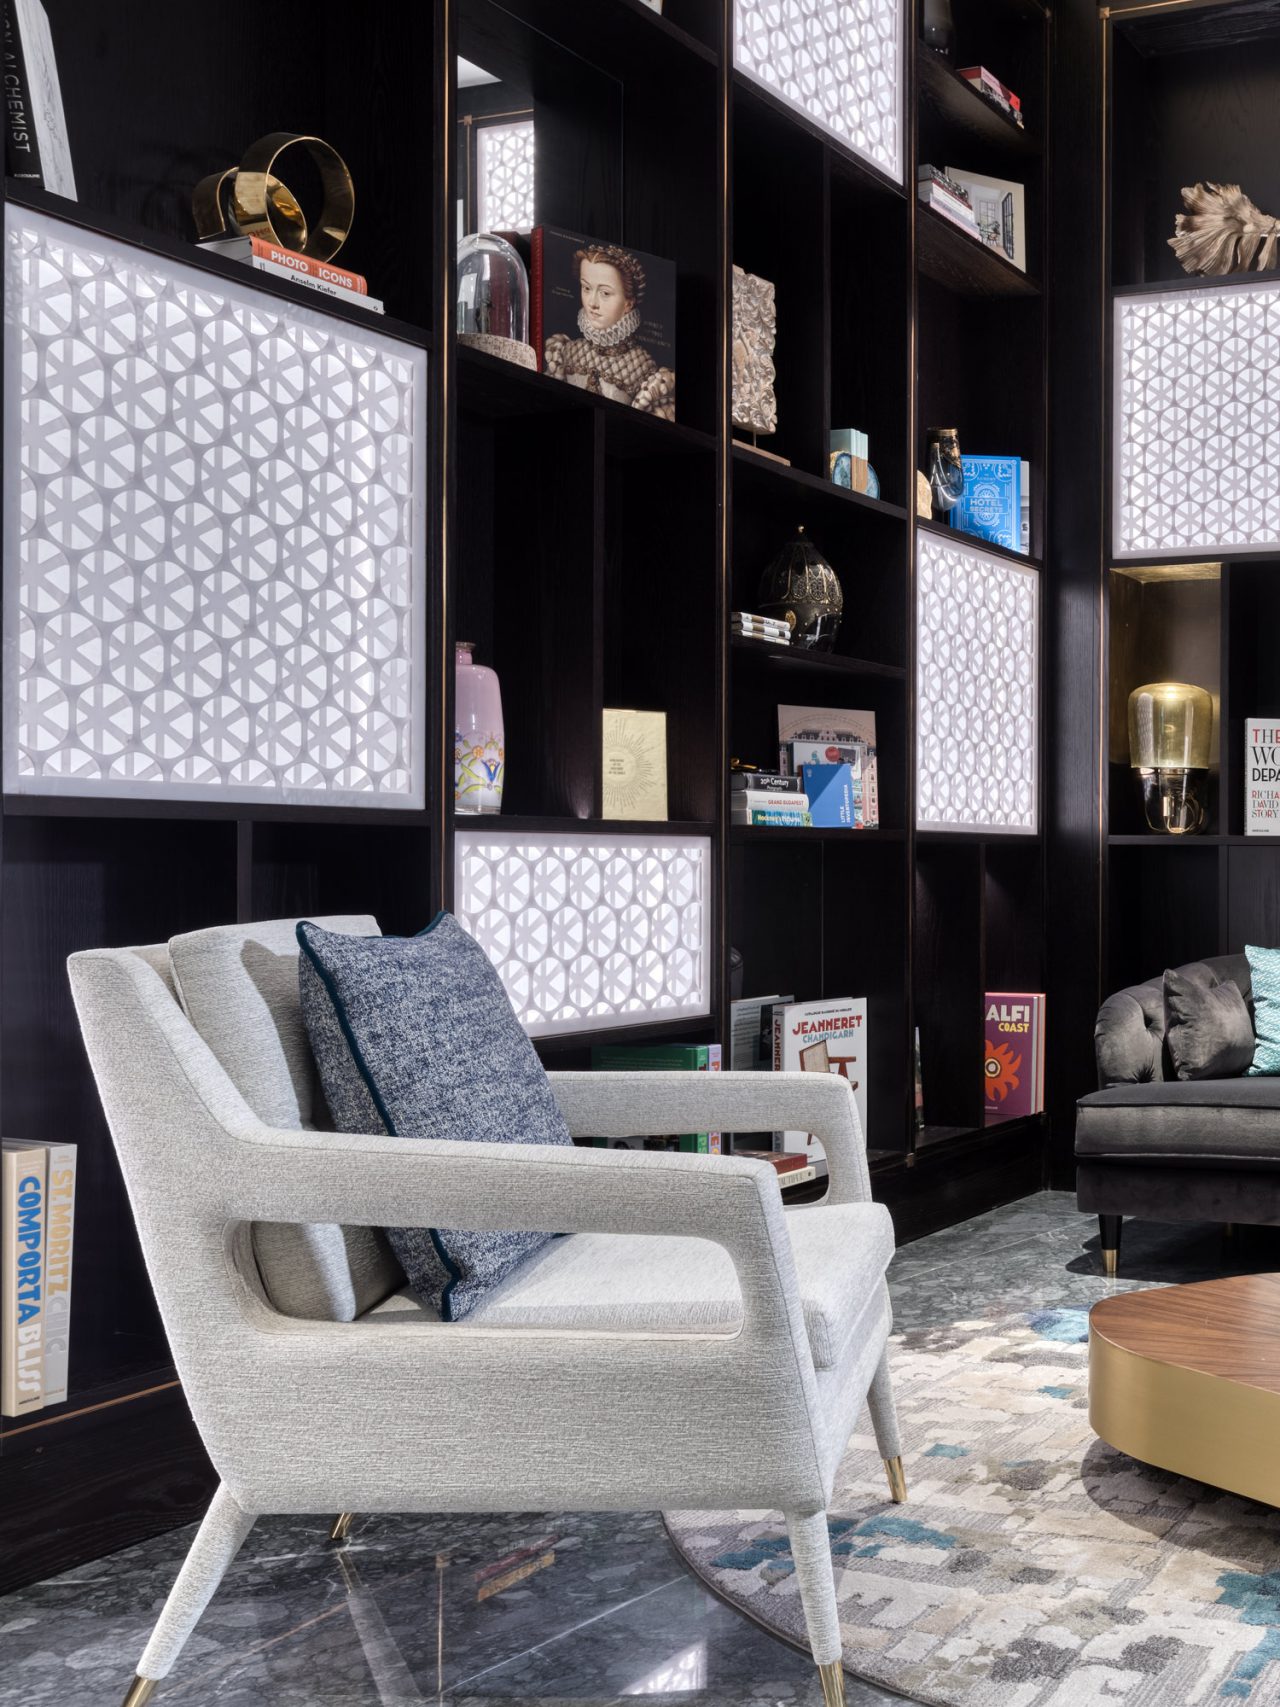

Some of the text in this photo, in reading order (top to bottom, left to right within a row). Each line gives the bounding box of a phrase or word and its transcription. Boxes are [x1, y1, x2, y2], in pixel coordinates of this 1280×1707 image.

[271, 250, 353, 288] PHOTO ICONS
[290, 274, 337, 296] Anselm Kiefer
[970, 498, 1003, 506] HOTEL
[770, 778, 789, 788] Century
[1252, 799, 1279, 809] DAVID
[1251, 809, 1279, 819] STORY
[985, 1004, 1030, 1022] ALFI
[792, 1015, 863, 1036] JEANNERET
[998, 1022, 1029, 1033] COAST
[773, 1019, 782, 1071] JEANNER
[802, 1029, 854, 1044] CHANDIGARH
[17, 1175, 42, 1325] COMPORTA
[45, 1169, 74, 1357] ST. MORITZ CHIC
[17, 1323, 42, 1393] BLISS
